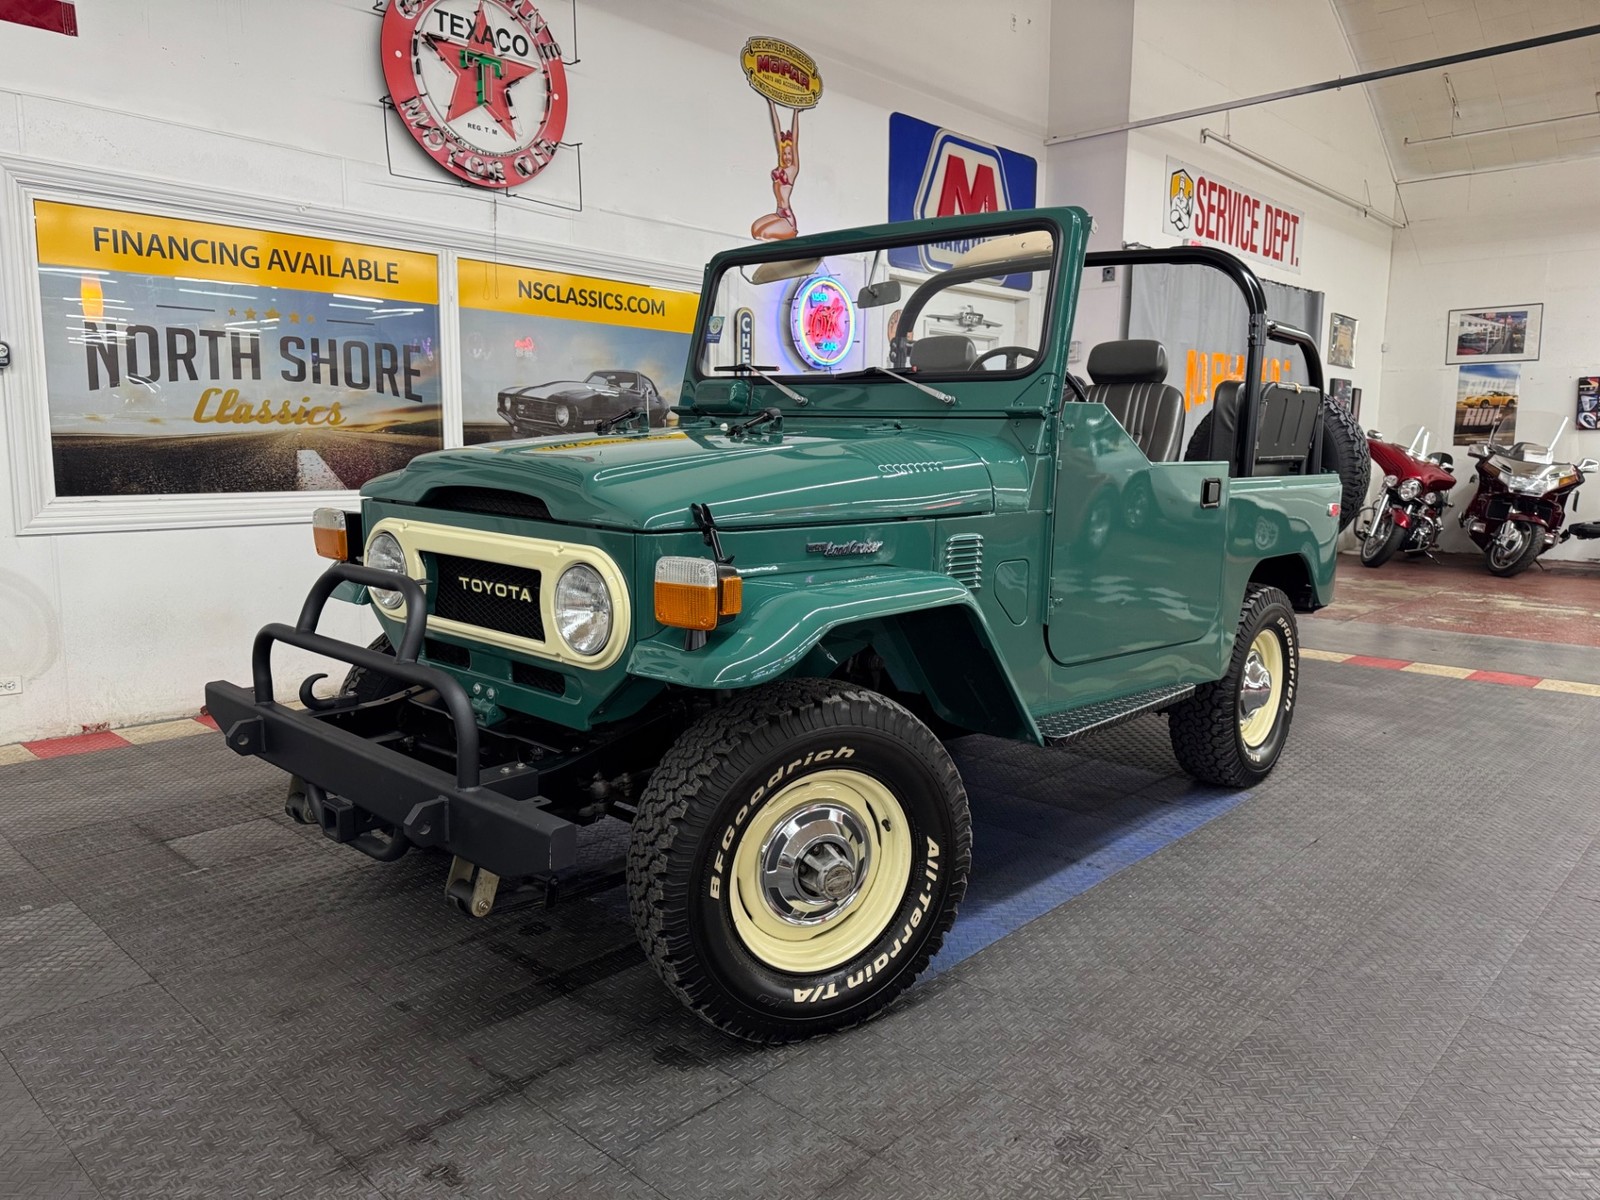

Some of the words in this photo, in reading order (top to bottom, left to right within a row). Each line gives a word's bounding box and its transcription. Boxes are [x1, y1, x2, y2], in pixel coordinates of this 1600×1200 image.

[433, 9, 529, 57] TEXACO
[756, 54, 810, 91] MOPAR
[400, 96, 507, 184] MOTOR
[1194, 176, 1261, 254] SERVICE
[1262, 204, 1300, 267] DEPT.
[93, 227, 260, 270] FINANCING
[267, 248, 400, 285] AVAILABLE
[518, 279, 666, 317] NSCLASSICS.COM
[83, 321, 262, 391] NORTH
[279, 335, 423, 403] SHORE
[193, 387, 347, 426] Classics
[458, 576, 532, 603] TOYOTA
[709, 746, 855, 900] BFGoodrich
[847, 836, 940, 990] All-Terrain
[793, 982, 840, 1003] T/A
